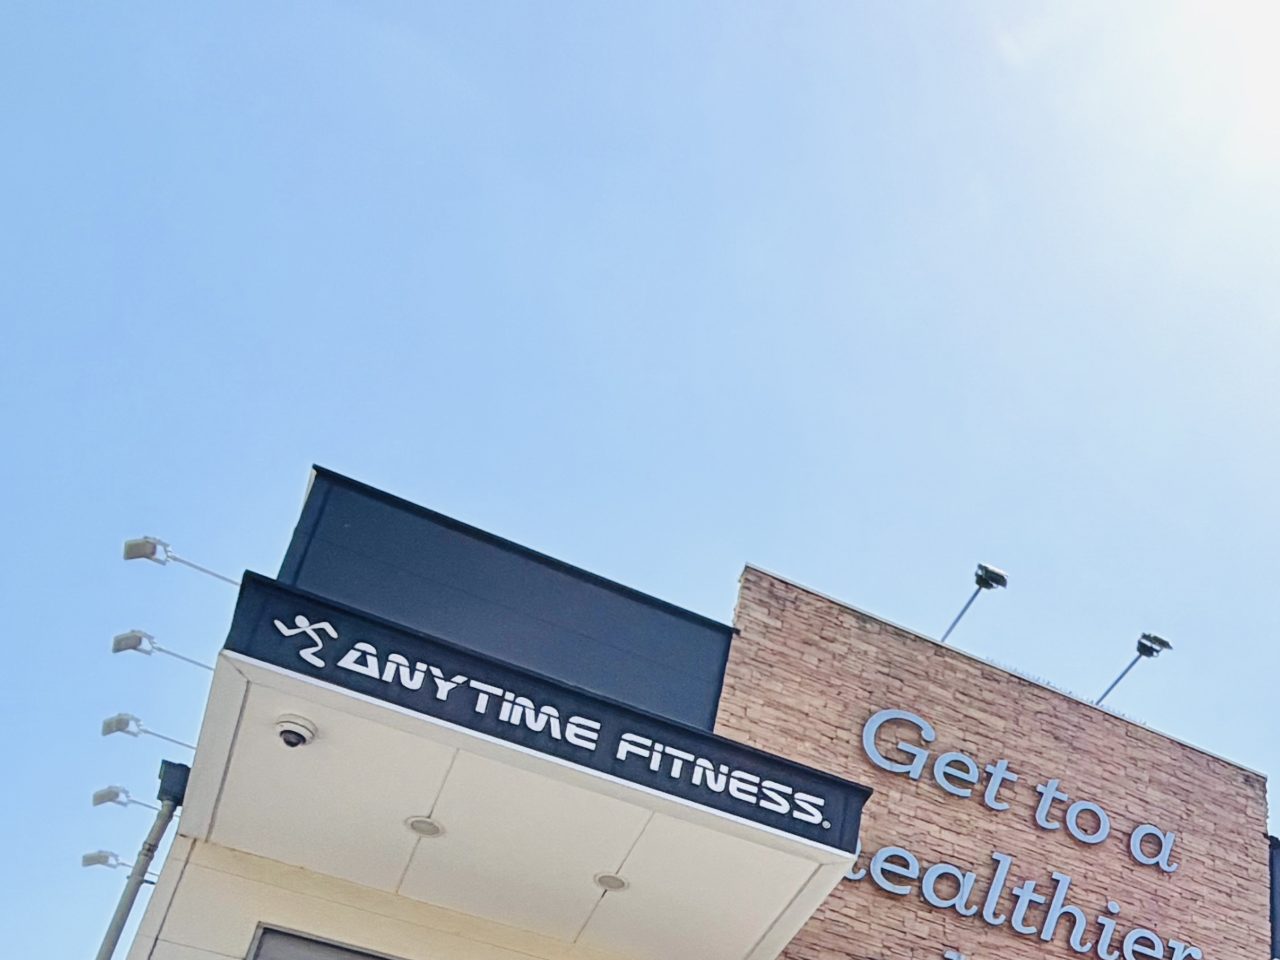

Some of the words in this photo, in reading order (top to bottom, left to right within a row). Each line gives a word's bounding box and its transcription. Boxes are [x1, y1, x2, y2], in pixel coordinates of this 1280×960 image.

[862, 708, 1018, 811] Get
[1034, 778, 1111, 844] to
[1129, 823, 1178, 873] a
